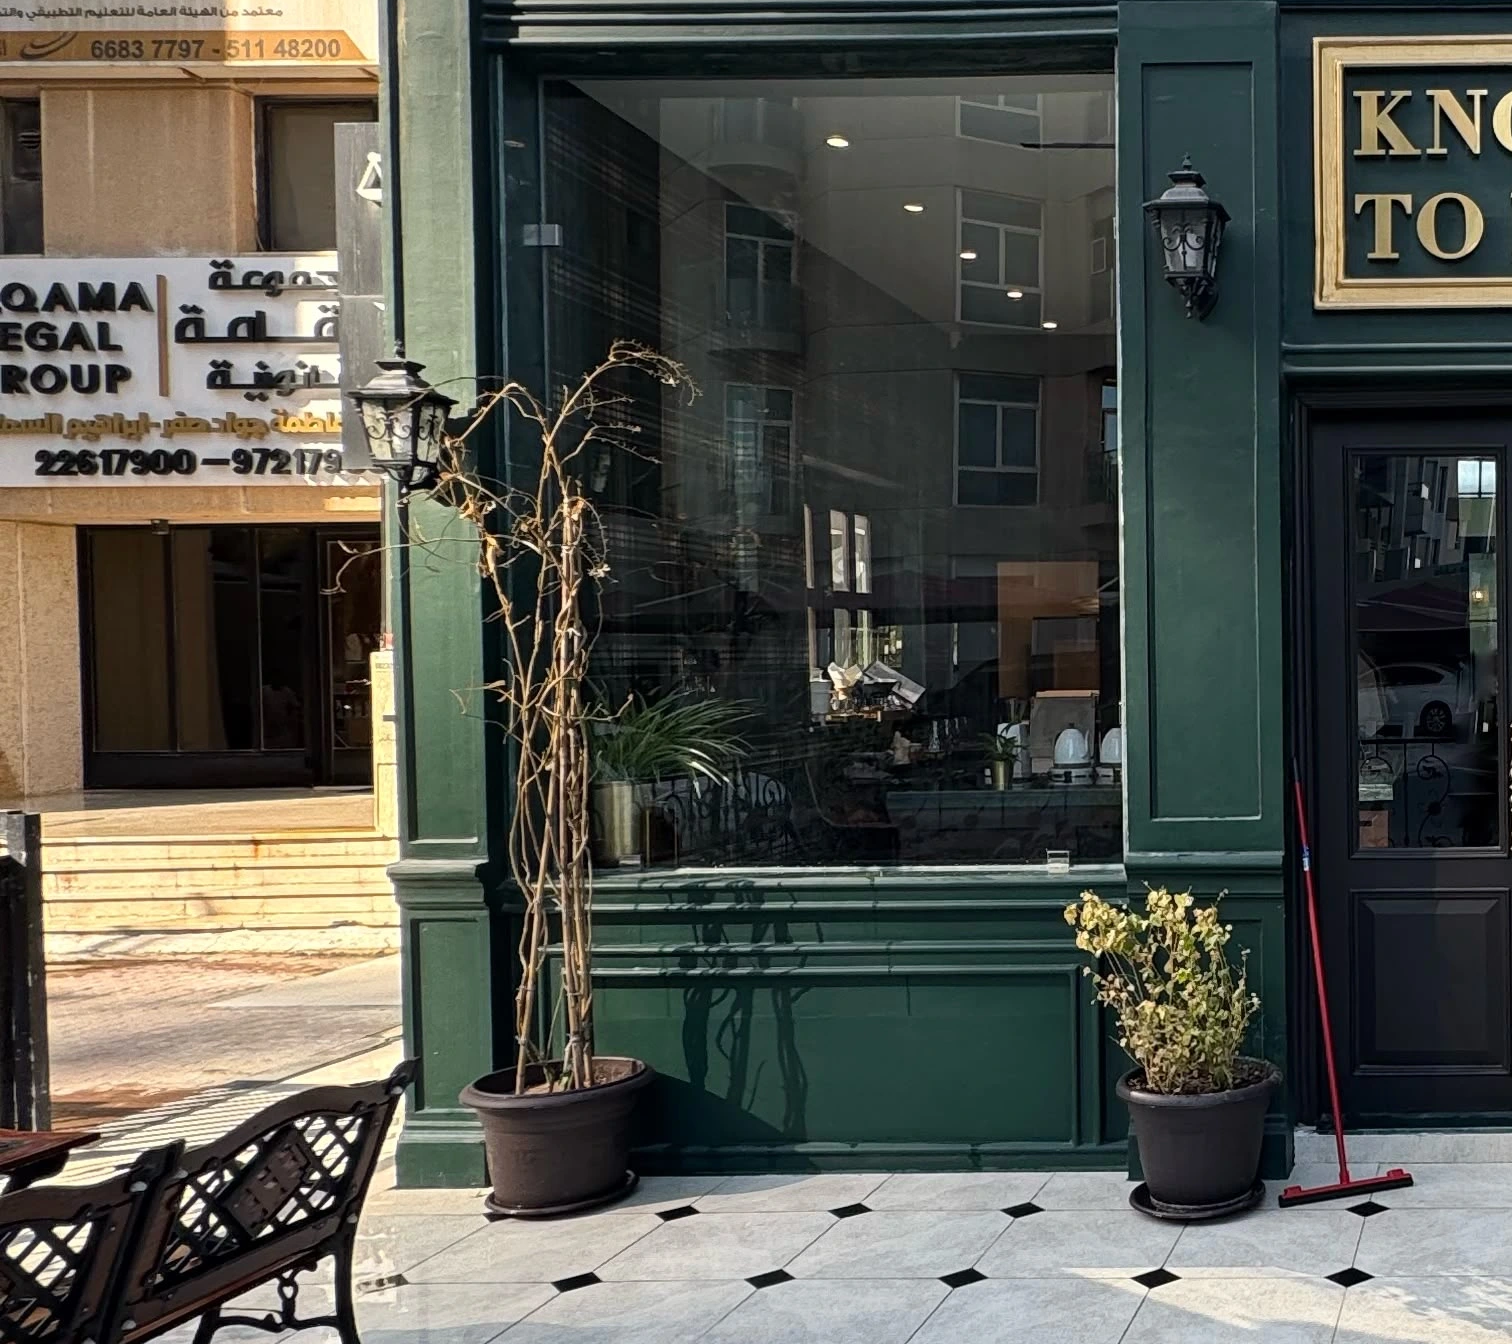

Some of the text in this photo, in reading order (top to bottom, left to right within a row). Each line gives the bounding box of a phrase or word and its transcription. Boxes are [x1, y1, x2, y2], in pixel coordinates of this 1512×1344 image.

[137, 6, 176, 18] العامة
[220, 7, 239, 19] من
[242, 6, 283, 18] معتمد
[91, 39, 144, 59] 6683
[151, 39, 205, 58] 7797
[225, 39, 264, 58] 511
[274, 38, 341, 58] 48200
[1354, 191, 1485, 260] TO
[0, 282, 154, 314] QAMA
[35, 448, 197, 477] 22617900
